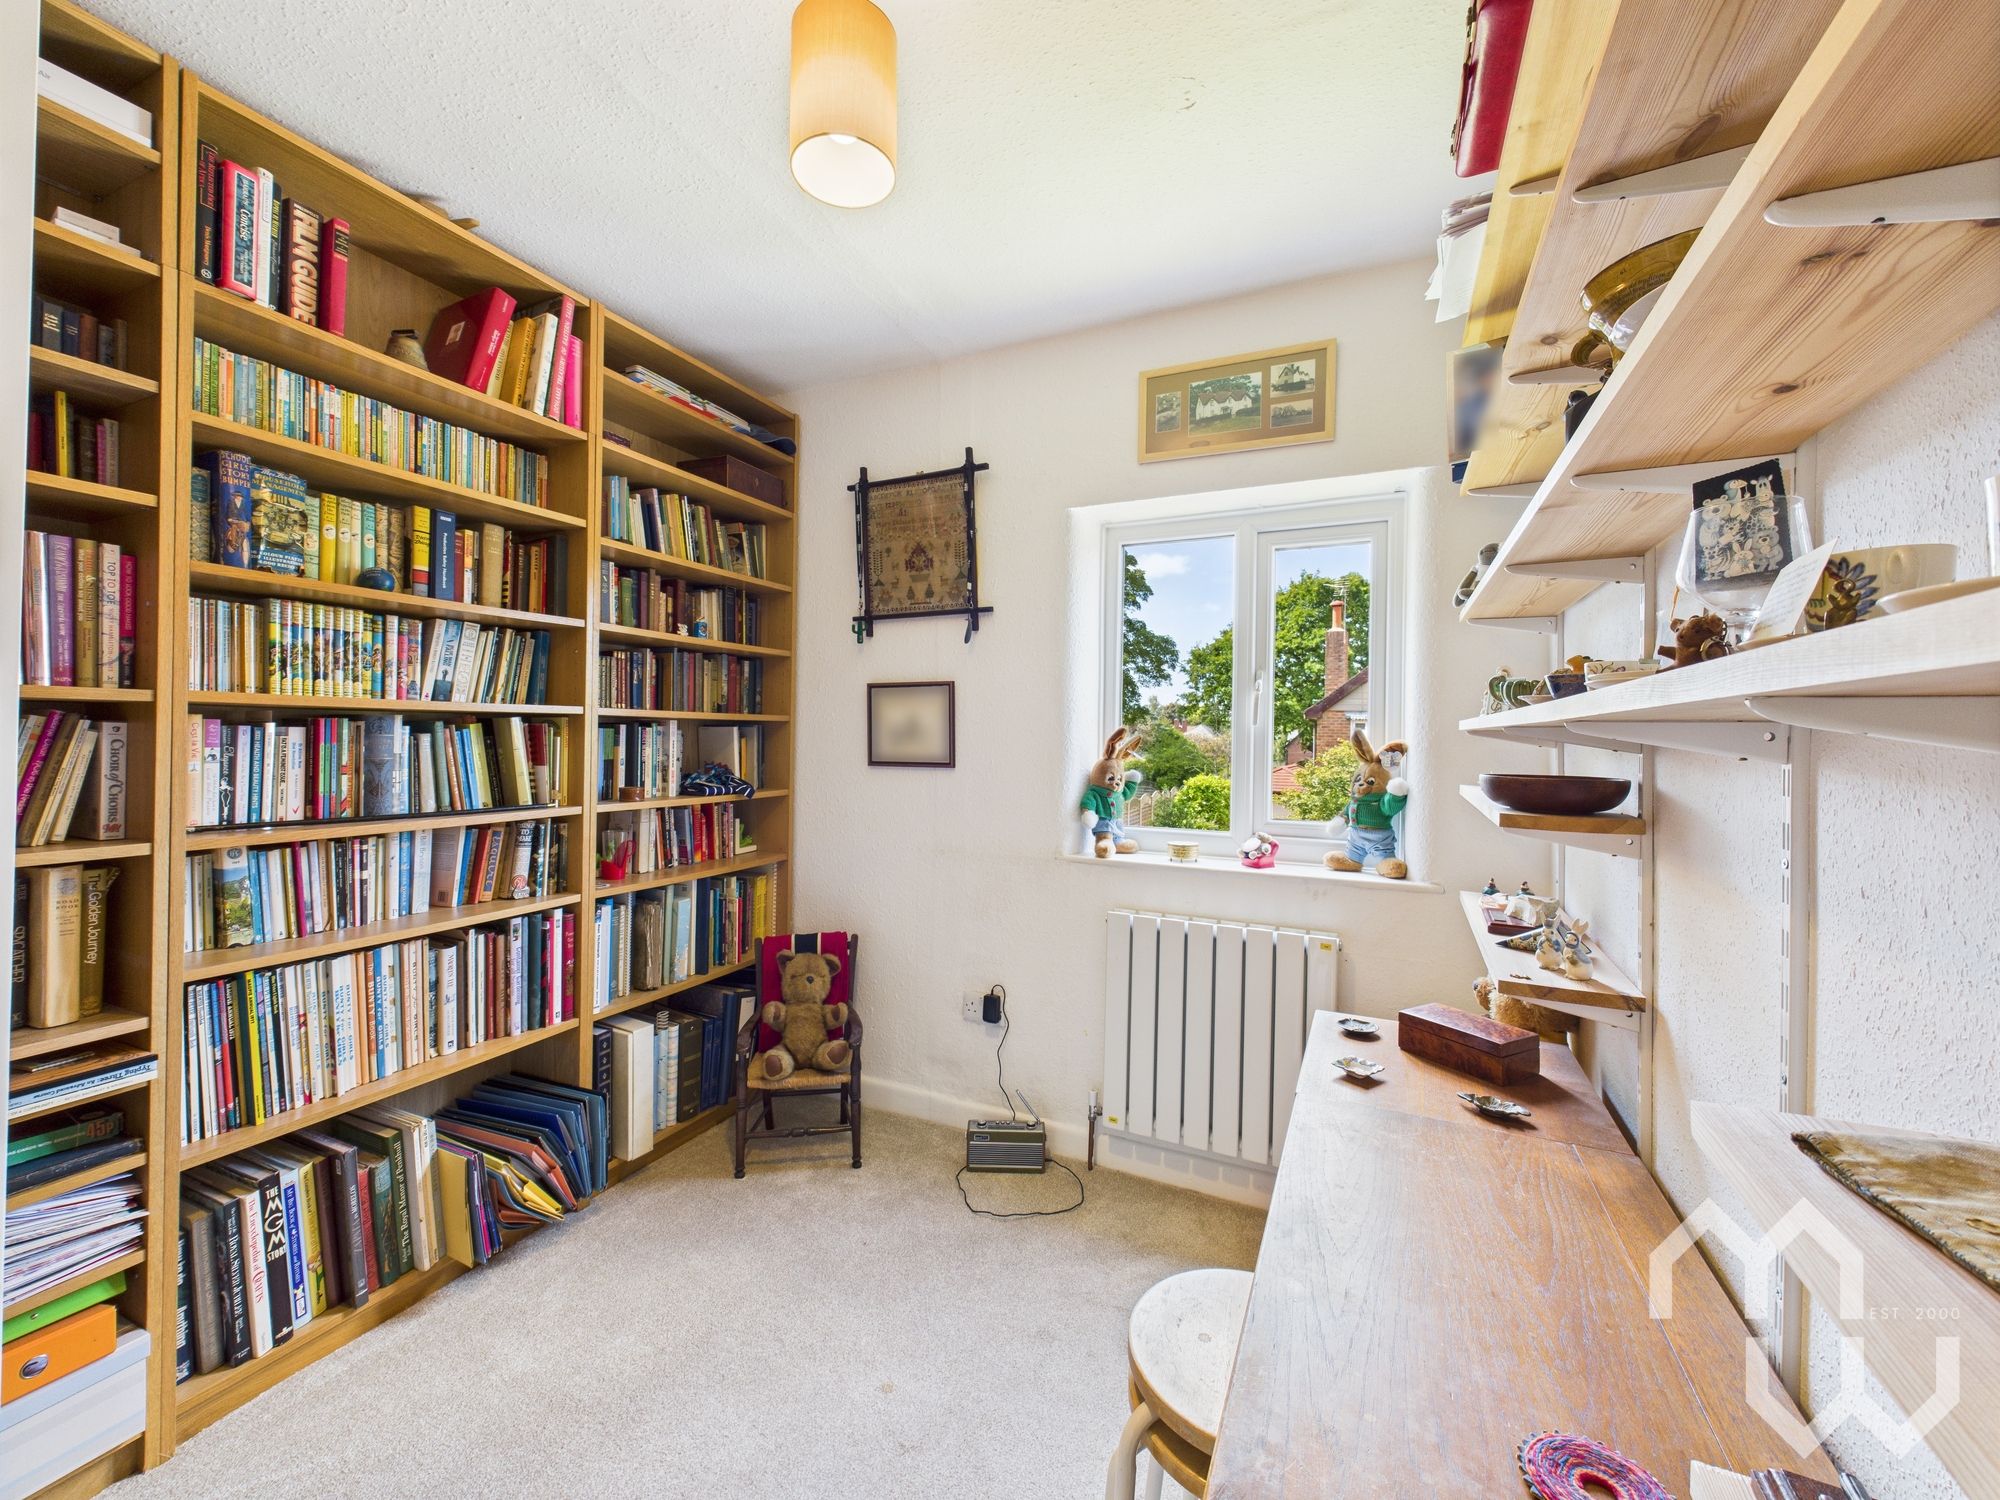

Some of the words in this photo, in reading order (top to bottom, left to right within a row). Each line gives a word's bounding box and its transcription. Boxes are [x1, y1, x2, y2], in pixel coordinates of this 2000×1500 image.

[239, 208, 251, 241] Concise
[292, 208, 319, 263] FILM
[291, 259, 317, 326] GUIDE
[564, 302, 572, 318] TALES
[562, 320, 571, 345] EASTERN
[561, 347, 567, 355] OF
[556, 357, 566, 385] TREASURY
[107, 562, 116, 576] TOP
[107, 578, 115, 589] TO
[107, 591, 115, 605] TOE
[220, 745, 234, 775] Elegance
[253, 741, 261, 761] HEALTH
[104, 772, 124, 785] of
[252, 773, 260, 793] BEAUTY
[88, 874, 101, 891] The
[88, 892, 102, 926] Golden
[84, 927, 101, 965] Journey
[97, 1072, 123, 1083] Three:
[124, 1065, 152, 1078] Typing
[33, 1089, 55, 1099] Course
[56, 1082, 85, 1093] Advanced
[394, 1141, 404, 1173] Penkhull
[396, 1174, 404, 1182] of
[265, 1185, 280, 1200] THE
[398, 1184, 406, 1209] Manor
[288, 1209, 296, 1224] BOOK
[400, 1209, 409, 1229] Royal
[228, 1235, 239, 1258] ROYAL
[248, 1213, 260, 1263] Encyclopedia
[401, 1230, 410, 1247] The
[230, 1258, 241, 1285] SILVER
[252, 1271, 265, 1304] CRAFTS
[233, 1286, 243, 1318] JUBILEE
